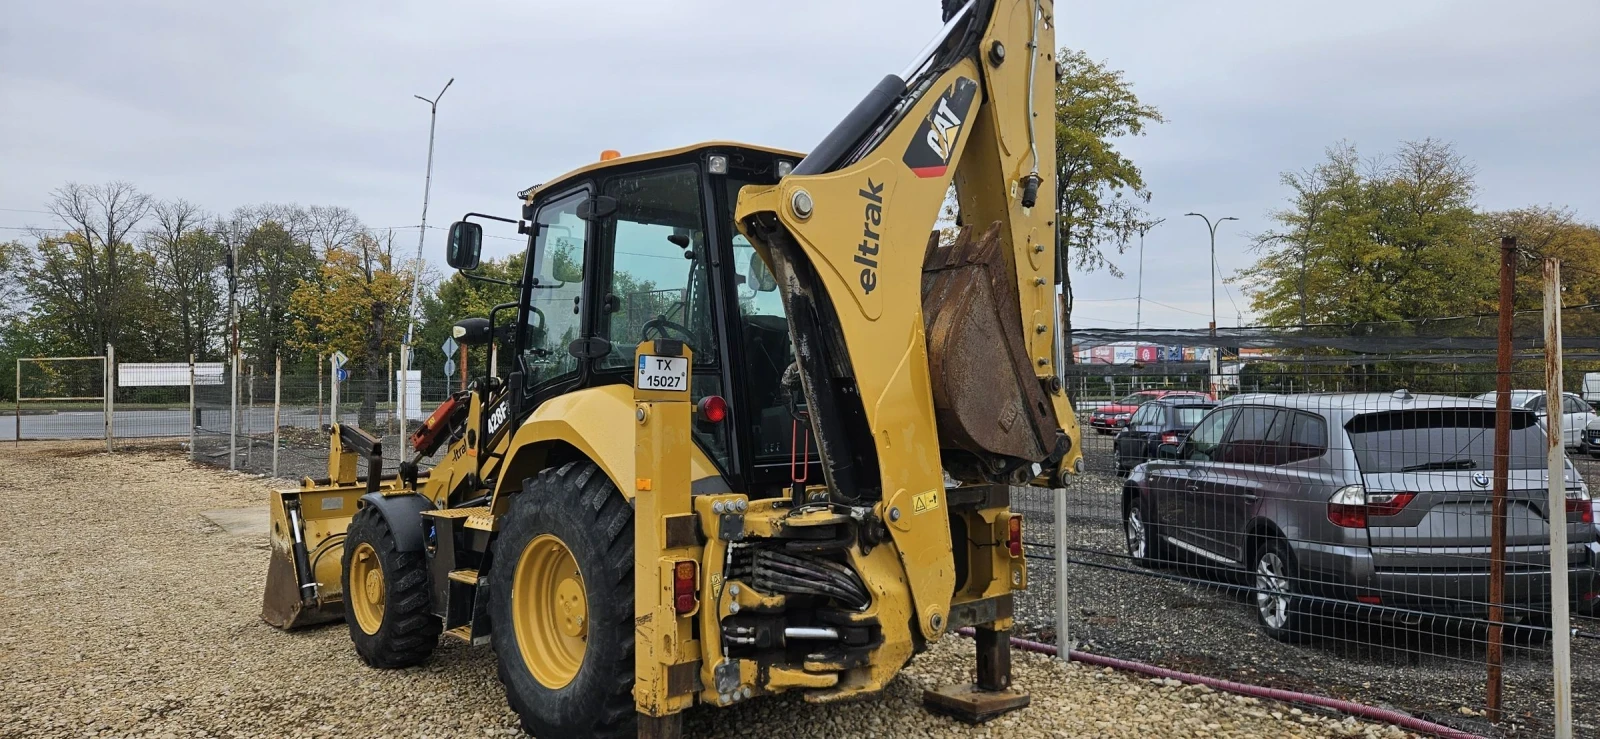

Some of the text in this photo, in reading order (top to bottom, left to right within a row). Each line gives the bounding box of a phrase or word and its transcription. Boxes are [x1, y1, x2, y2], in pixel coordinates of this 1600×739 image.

[927, 97, 961, 160] CAT
[853, 177, 884, 294] eltrak
[647, 375, 681, 388] 15027
[656, 359, 672, 371] TX
